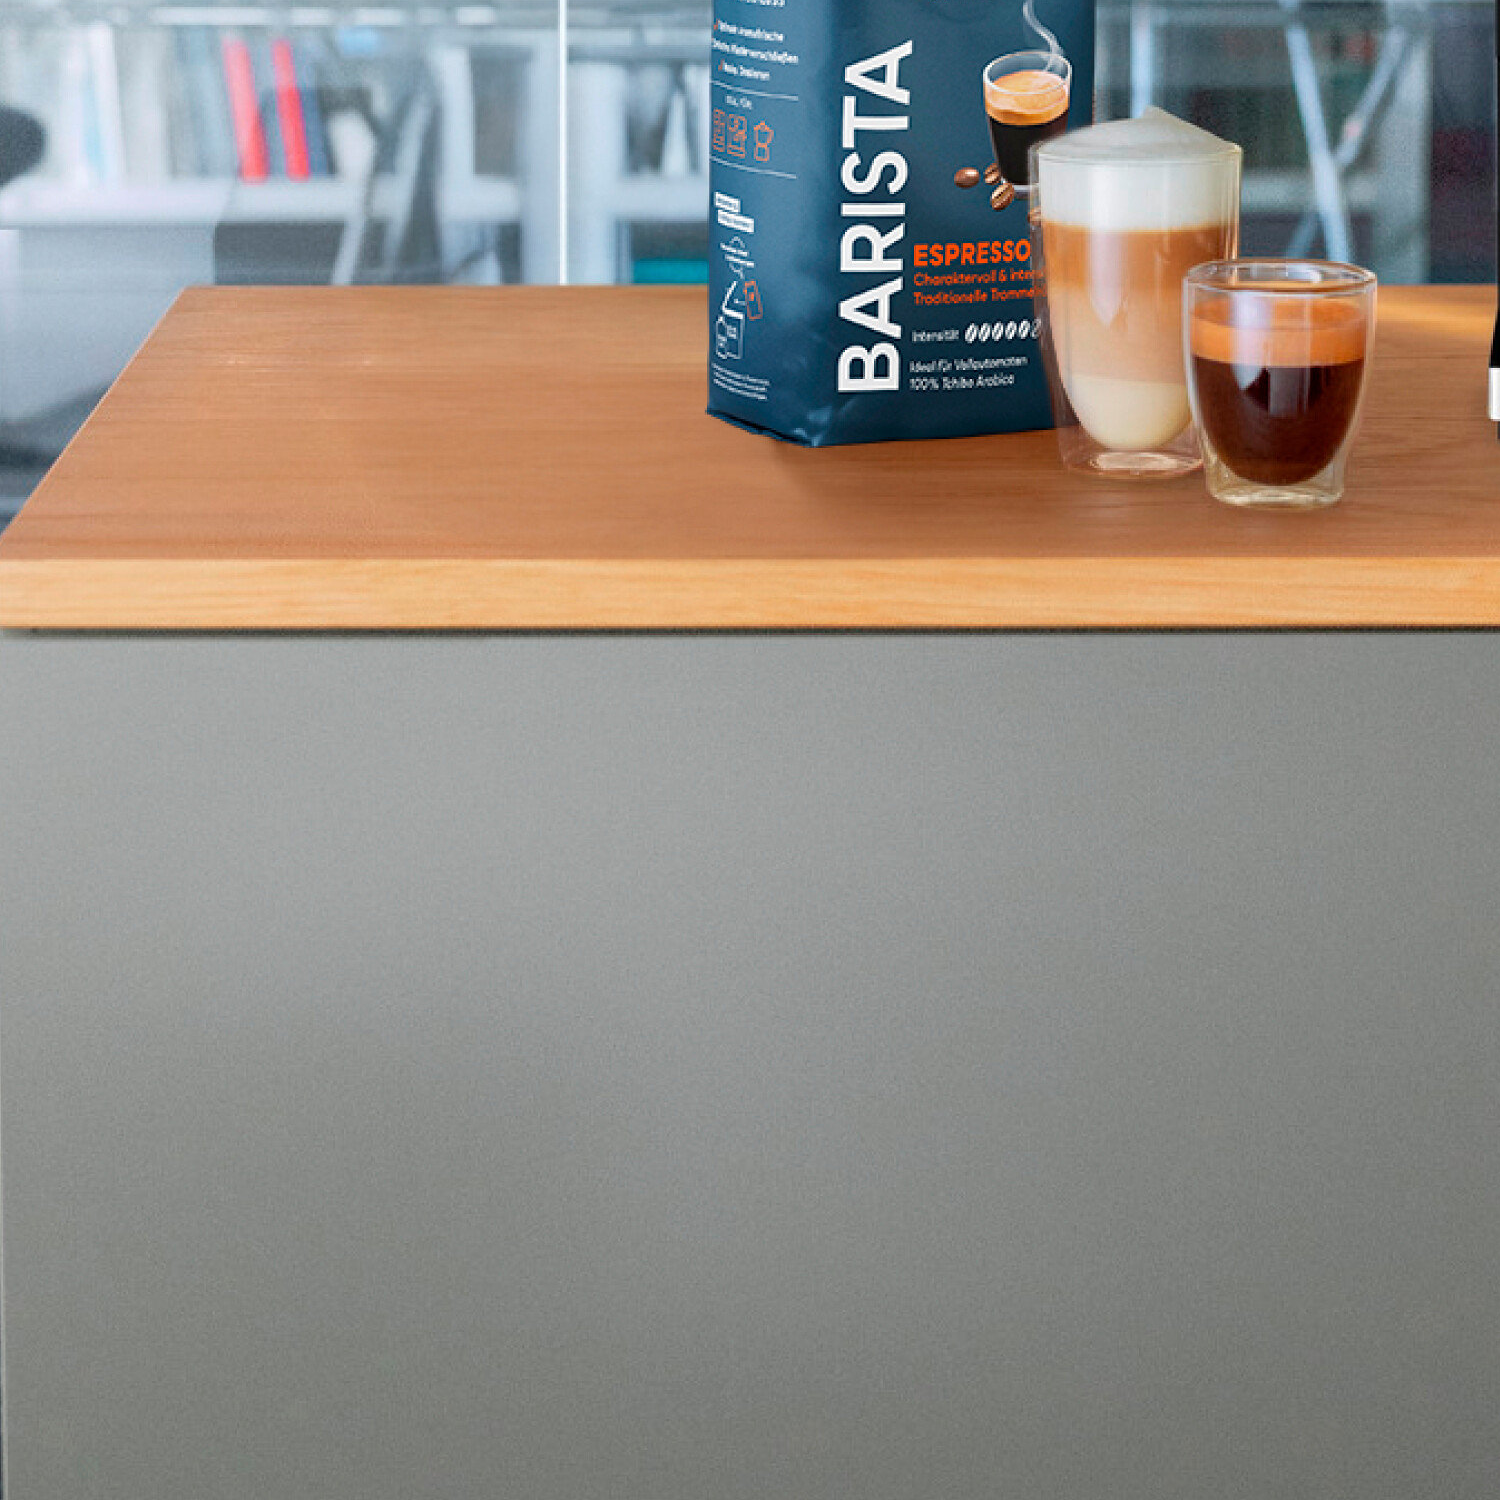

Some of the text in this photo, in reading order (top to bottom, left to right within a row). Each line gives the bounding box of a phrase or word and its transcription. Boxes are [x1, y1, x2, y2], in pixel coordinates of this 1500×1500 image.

[838, 40, 913, 392] BARISTA
[913, 238, 1031, 267] ESPRESSO
[913, 269, 997, 286] Charaktervoll
[913, 289, 988, 306] Traditionelle
[953, 356, 1028, 371] Vollautomaten
